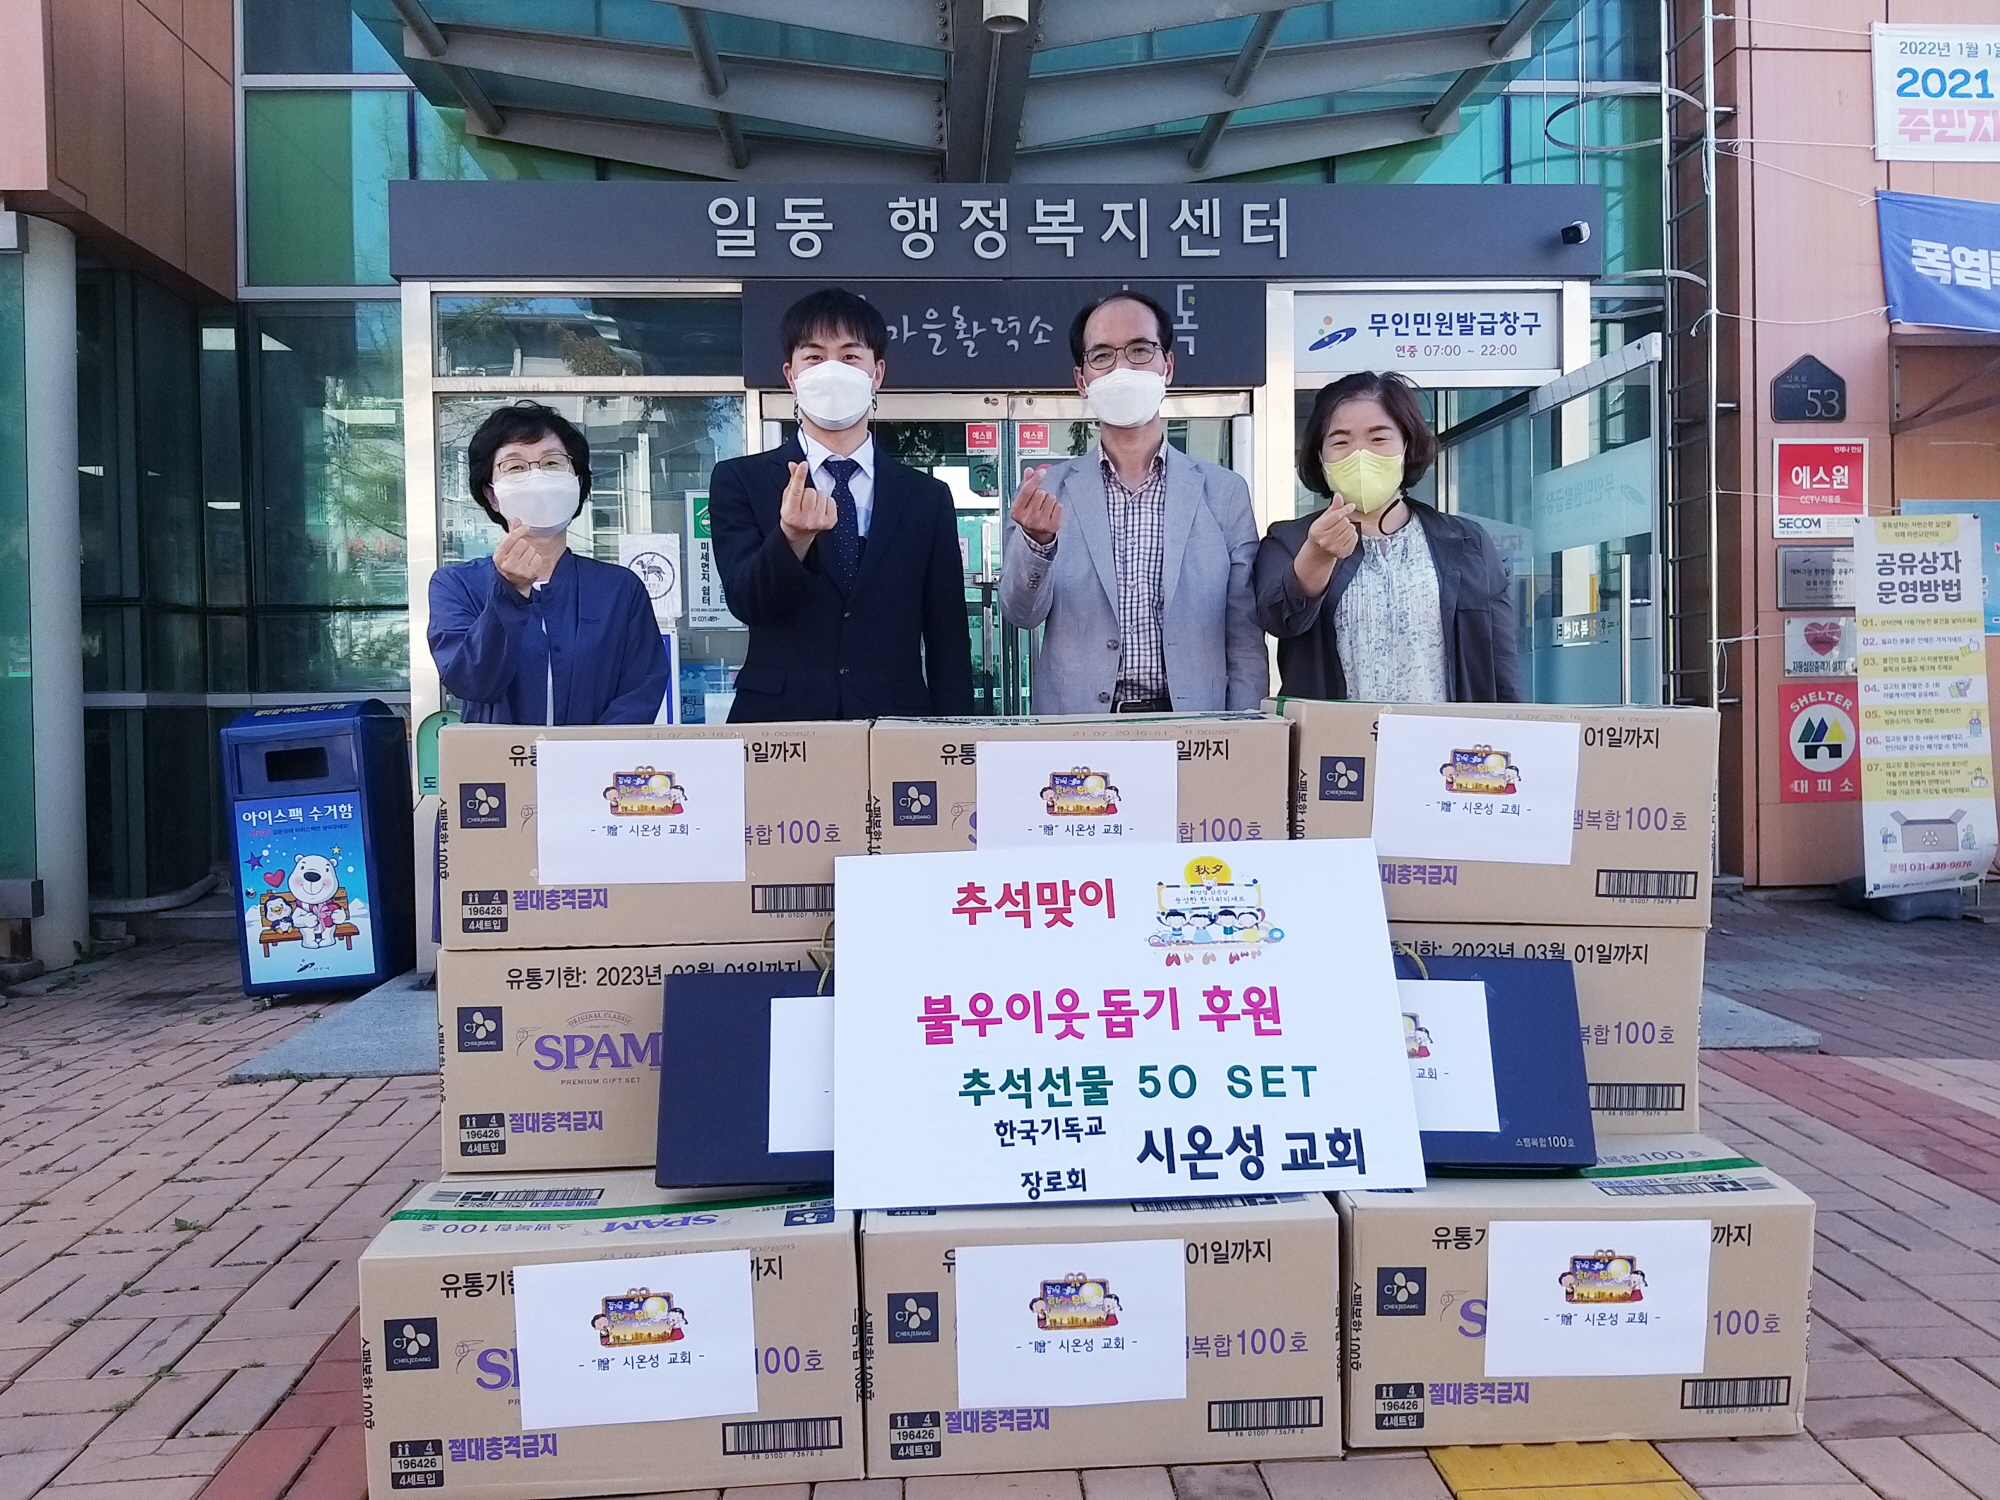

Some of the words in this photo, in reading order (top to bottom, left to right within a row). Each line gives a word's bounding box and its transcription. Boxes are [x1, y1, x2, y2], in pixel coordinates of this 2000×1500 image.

[1899, 41, 1951, 58] 2022년
[1957, 42, 1979, 58] 1월
[1896, 67, 1994, 99] 2021
[706, 195, 835, 259] 일동
[887, 195, 1290, 261] 행정복지센터
[1368, 312, 1541, 337] 무인민원발급창구
[1395, 344, 1418, 358] 연중
[1424, 344, 1461, 356] 07:00
[1480, 344, 1517, 356] 22:00
[1805, 389, 1841, 418] 53
[1791, 465, 1849, 489] 에스원
[1779, 518, 1821, 529] SECOM
[700, 541, 710, 583] 미세먼지
[1875, 551, 1962, 577] 공유상자
[701, 585, 711, 606] 쉼터
[1876, 578, 1962, 604] 운영방법
[1862, 618, 1878, 627] 01.
[1862, 637, 1878, 646] 02.
[1863, 658, 1879, 667] 03.
[1864, 684, 1880, 693] 04.
[1789, 690, 1854, 713] SHELTER
[1865, 710, 1881, 719] 05.
[1583, 726, 1661, 750] 01일까지
[1865, 736, 1882, 745] 06.
[745, 740, 808, 765] 1일까지
[1866, 763, 1883, 772] 07.
[242, 807, 304, 827] 아이스팩
[308, 803, 354, 822] 수거함
[1462, 802, 1494, 816] 시온성
[1500, 803, 1521, 816] 교회
[629, 823, 661, 837] 시온성
[668, 823, 689, 836] 교회
[1065, 823, 1096, 837] 시온성
[1102, 822, 1124, 836] 교회
[1194, 864, 1223, 876] 秋夕
[1379, 863, 1458, 887] 대충격금지
[1889, 862, 1908, 874] 문의
[512, 888, 609, 911] 절대충격금지
[951, 876, 1116, 929] 추석맞이
[467, 906, 504, 916] 196426
[468, 918, 503, 932] 4세트입
[1574, 943, 1649, 964] 01일까지
[505, 967, 588, 991] 유통기한:
[596, 964, 664, 988] 2023년
[568, 1012, 602, 1027] ORIGINAL
[1198, 984, 1284, 1037] 후원
[532, 1031, 663, 1072] SPAM
[560, 1078, 600, 1086] PREMIUM
[602, 1077, 623, 1085] GIFT
[625, 1076, 642, 1084] SET
[1416, 1067, 1437, 1081] 교회
[958, 1066, 1114, 1109] 추석선물
[1138, 1064, 1198, 1099] 50
[1227, 1064, 1318, 1099] SET
[508, 1110, 603, 1133] 절대충격금지
[994, 1115, 1106, 1148] 한국기독교
[464, 1129, 501, 1140] 196426
[466, 1142, 500, 1155] 4세트입
[1137, 1123, 1265, 1180] 시온성
[1281, 1126, 1367, 1176] 교회
[1020, 1167, 1087, 1201] 장로회
[1185, 1238, 1272, 1266] 01일까지
[1584, 1312, 1618, 1327] 시온성
[1625, 1311, 1648, 1326] 교회
[1058, 1338, 1095, 1354] 시온성
[1101, 1335, 1125, 1351] 교회
[622, 1352, 659, 1370] 시온성
[668, 1349, 692, 1368] 교회
[1429, 1381, 1530, 1406] 절대충격금지
[1381, 1399, 1419, 1412] 196426
[945, 1408, 1050, 1434] 절대충격금지
[1382, 1414, 1418, 1429] 4세트입
[896, 1429, 935, 1442] 196426
[448, 1432, 558, 1463] 절대충격금지
[897, 1443, 935, 1458] 4세트입
[397, 1457, 437, 1470] 196426
[399, 1471, 437, 1487] 4세트입
